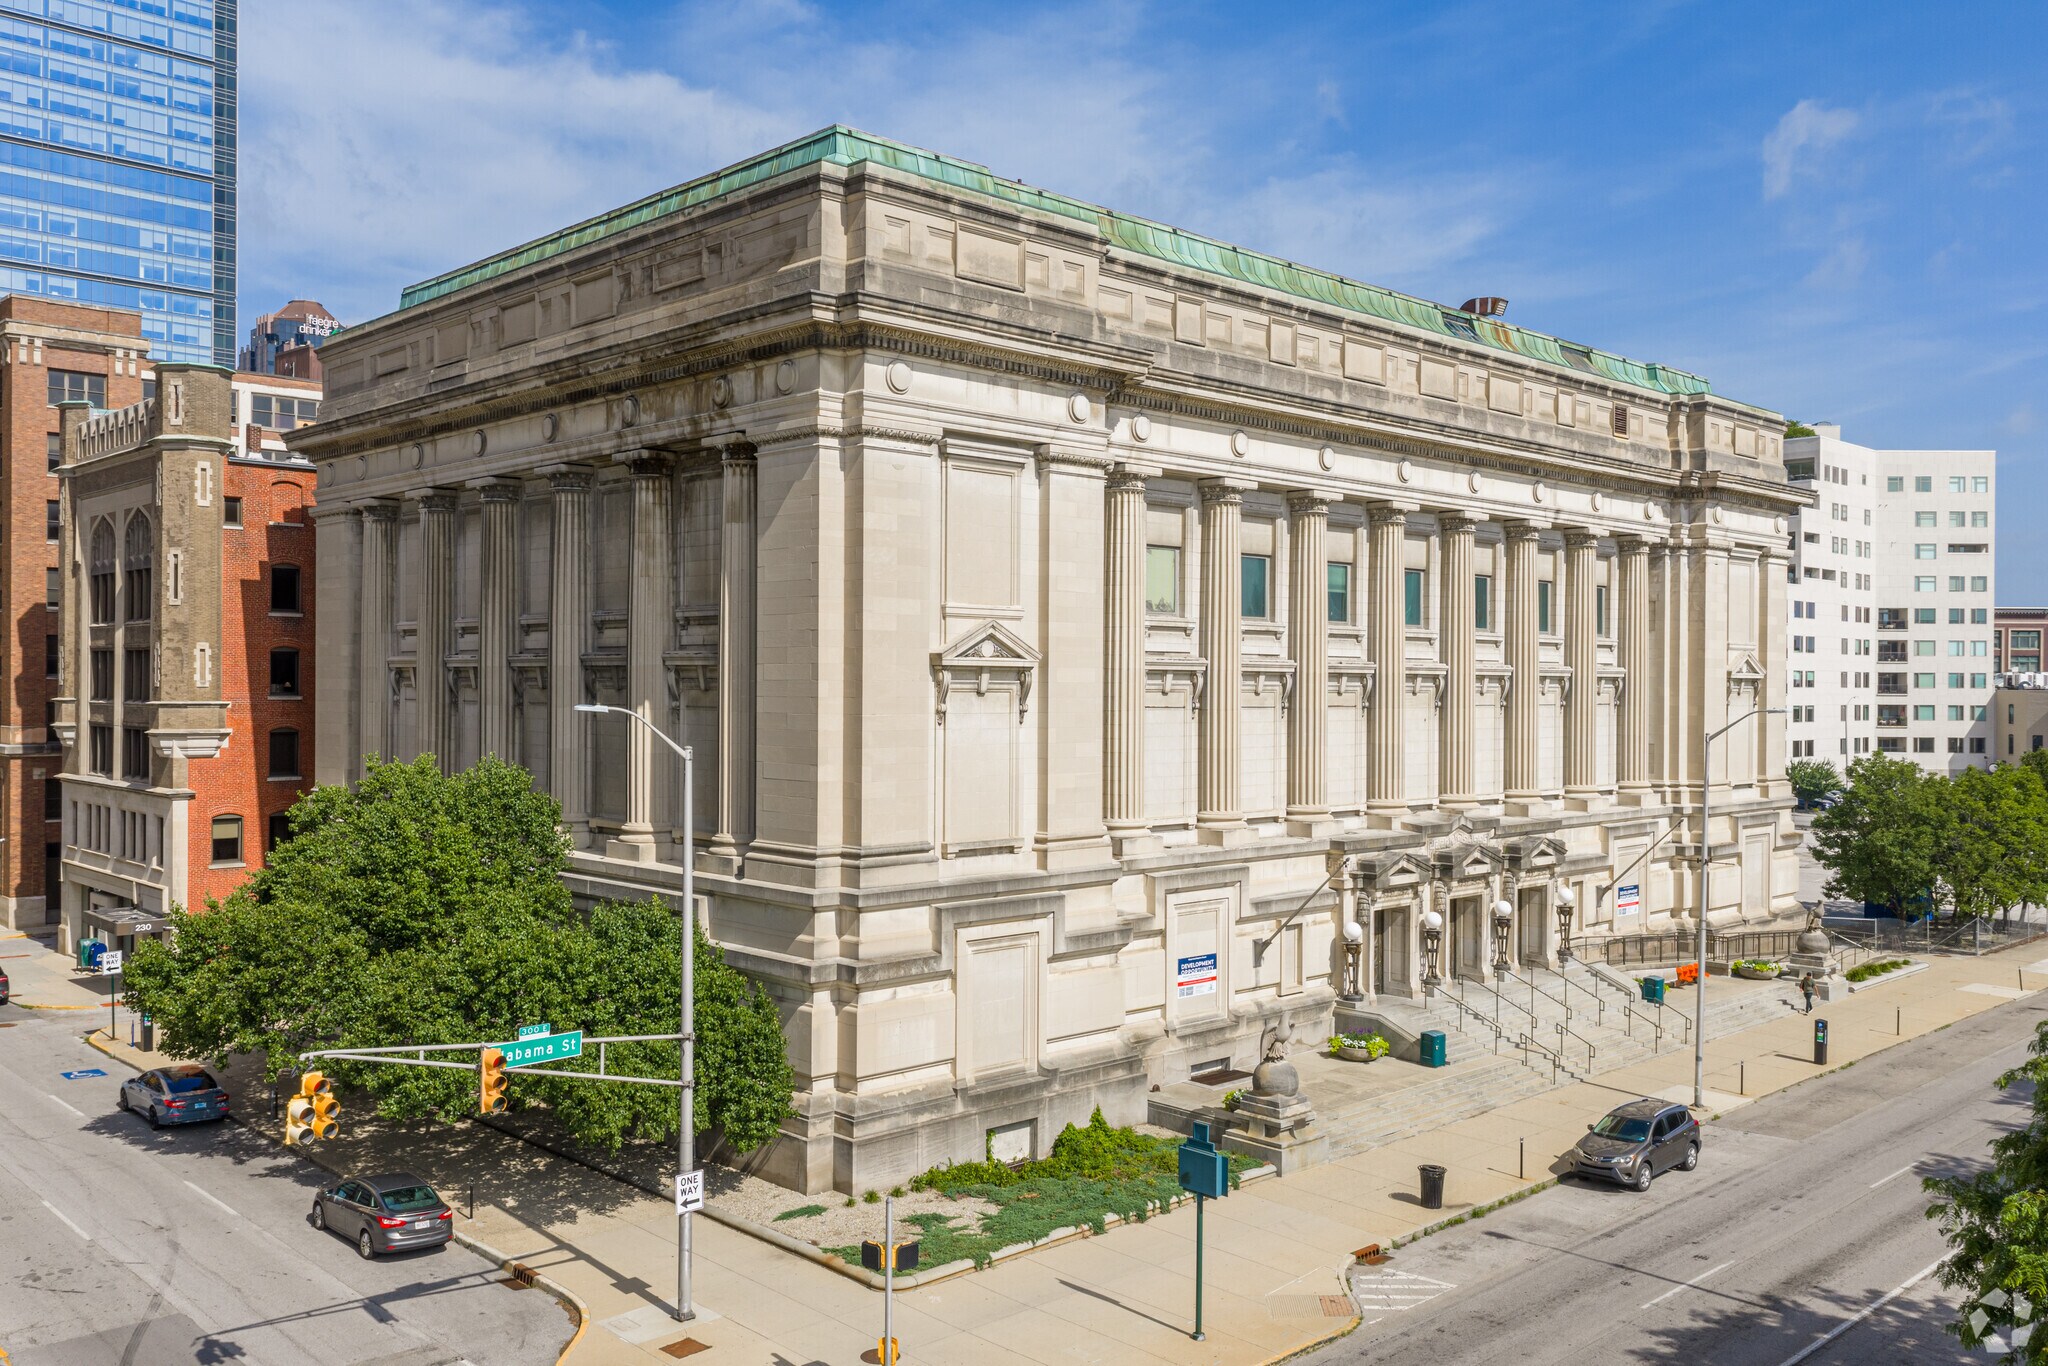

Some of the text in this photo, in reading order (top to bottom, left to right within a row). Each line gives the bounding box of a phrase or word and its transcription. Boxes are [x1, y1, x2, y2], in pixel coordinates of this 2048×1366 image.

[308, 314, 338, 329] faegre
[300, 323, 332, 336] drinker
[135, 923, 152, 932] 230
[1181, 959, 1214, 970] DEVELOPMENT
[522, 1027, 540, 1036] 300
[502, 1038, 576, 1061] abama St
[680, 1174, 698, 1186] ONE
[680, 1184, 698, 1196] WAY
